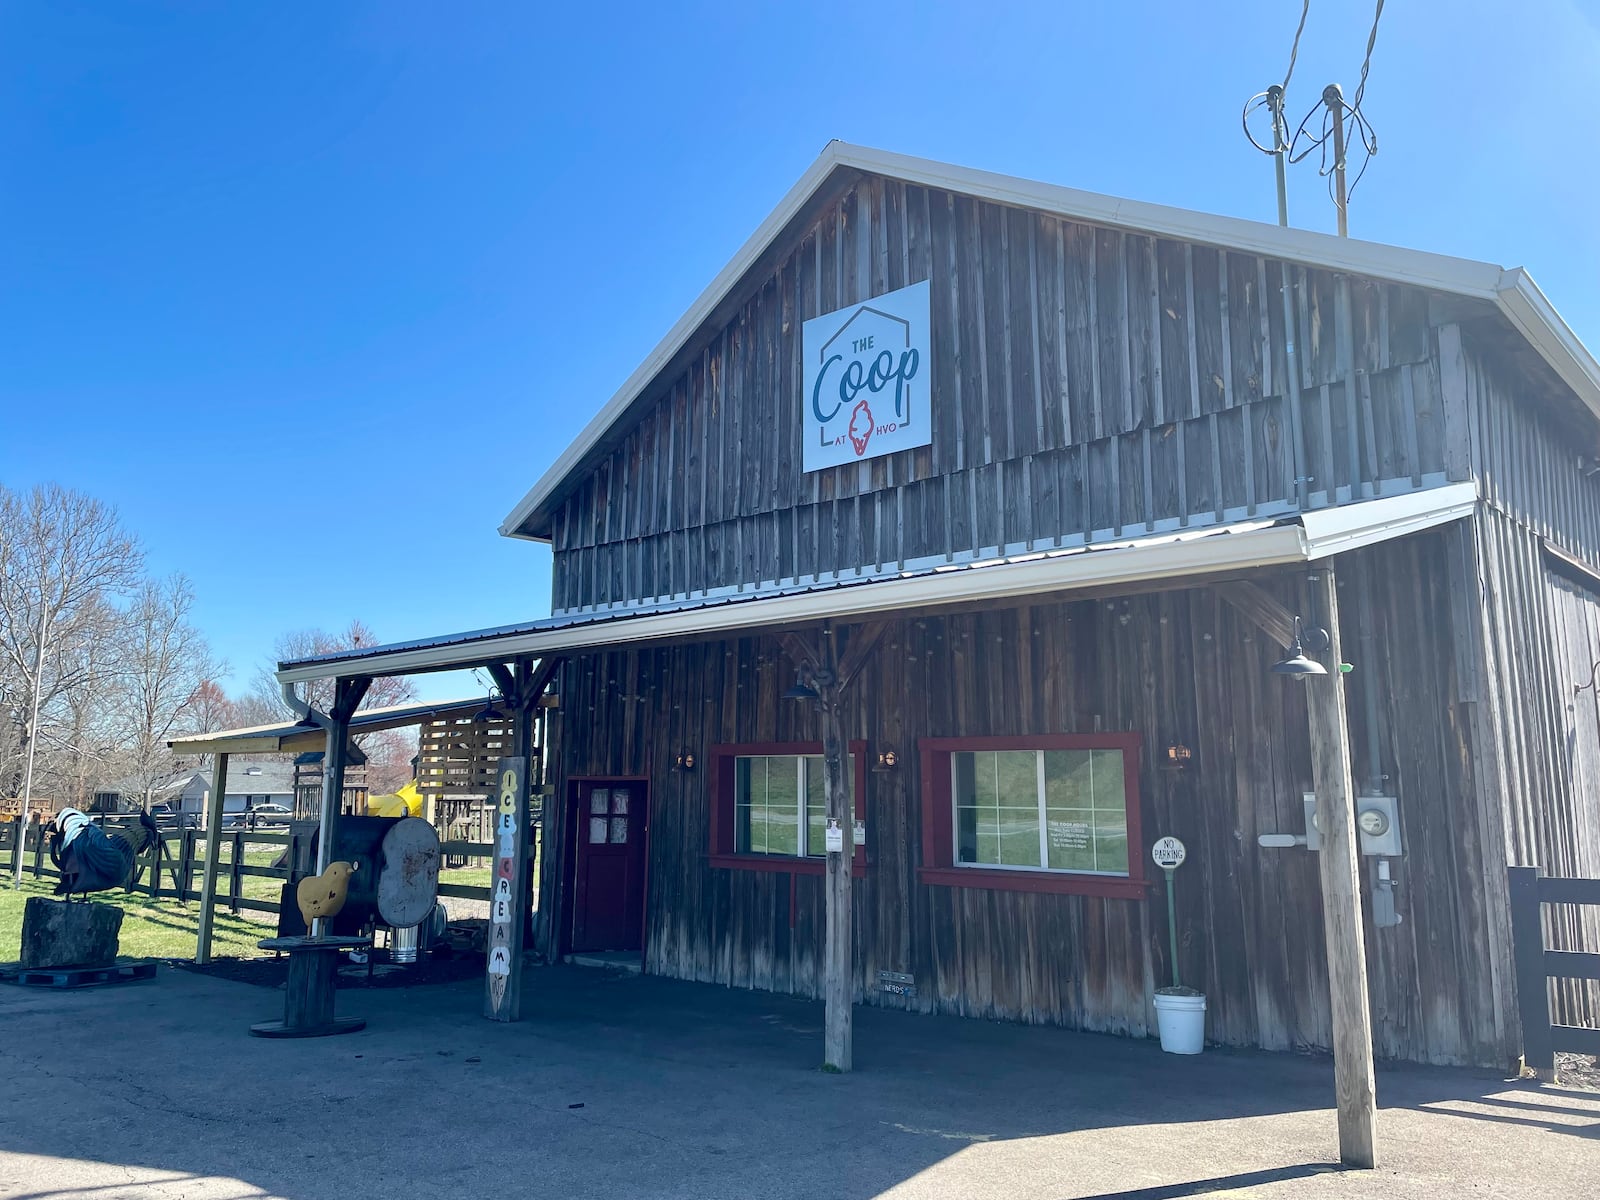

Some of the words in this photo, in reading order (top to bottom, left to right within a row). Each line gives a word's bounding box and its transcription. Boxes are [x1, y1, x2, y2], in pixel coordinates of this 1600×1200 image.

[852, 335, 874, 353] THE
[812, 348, 920, 423] Coop
[834, 434, 847, 446] AT
[876, 423, 897, 436] HVO
[504, 774, 512, 829] ICE
[1154, 849, 1183, 860] PARKING
[1163, 839, 1175, 850] NO
[494, 860, 509, 962] CREAM
